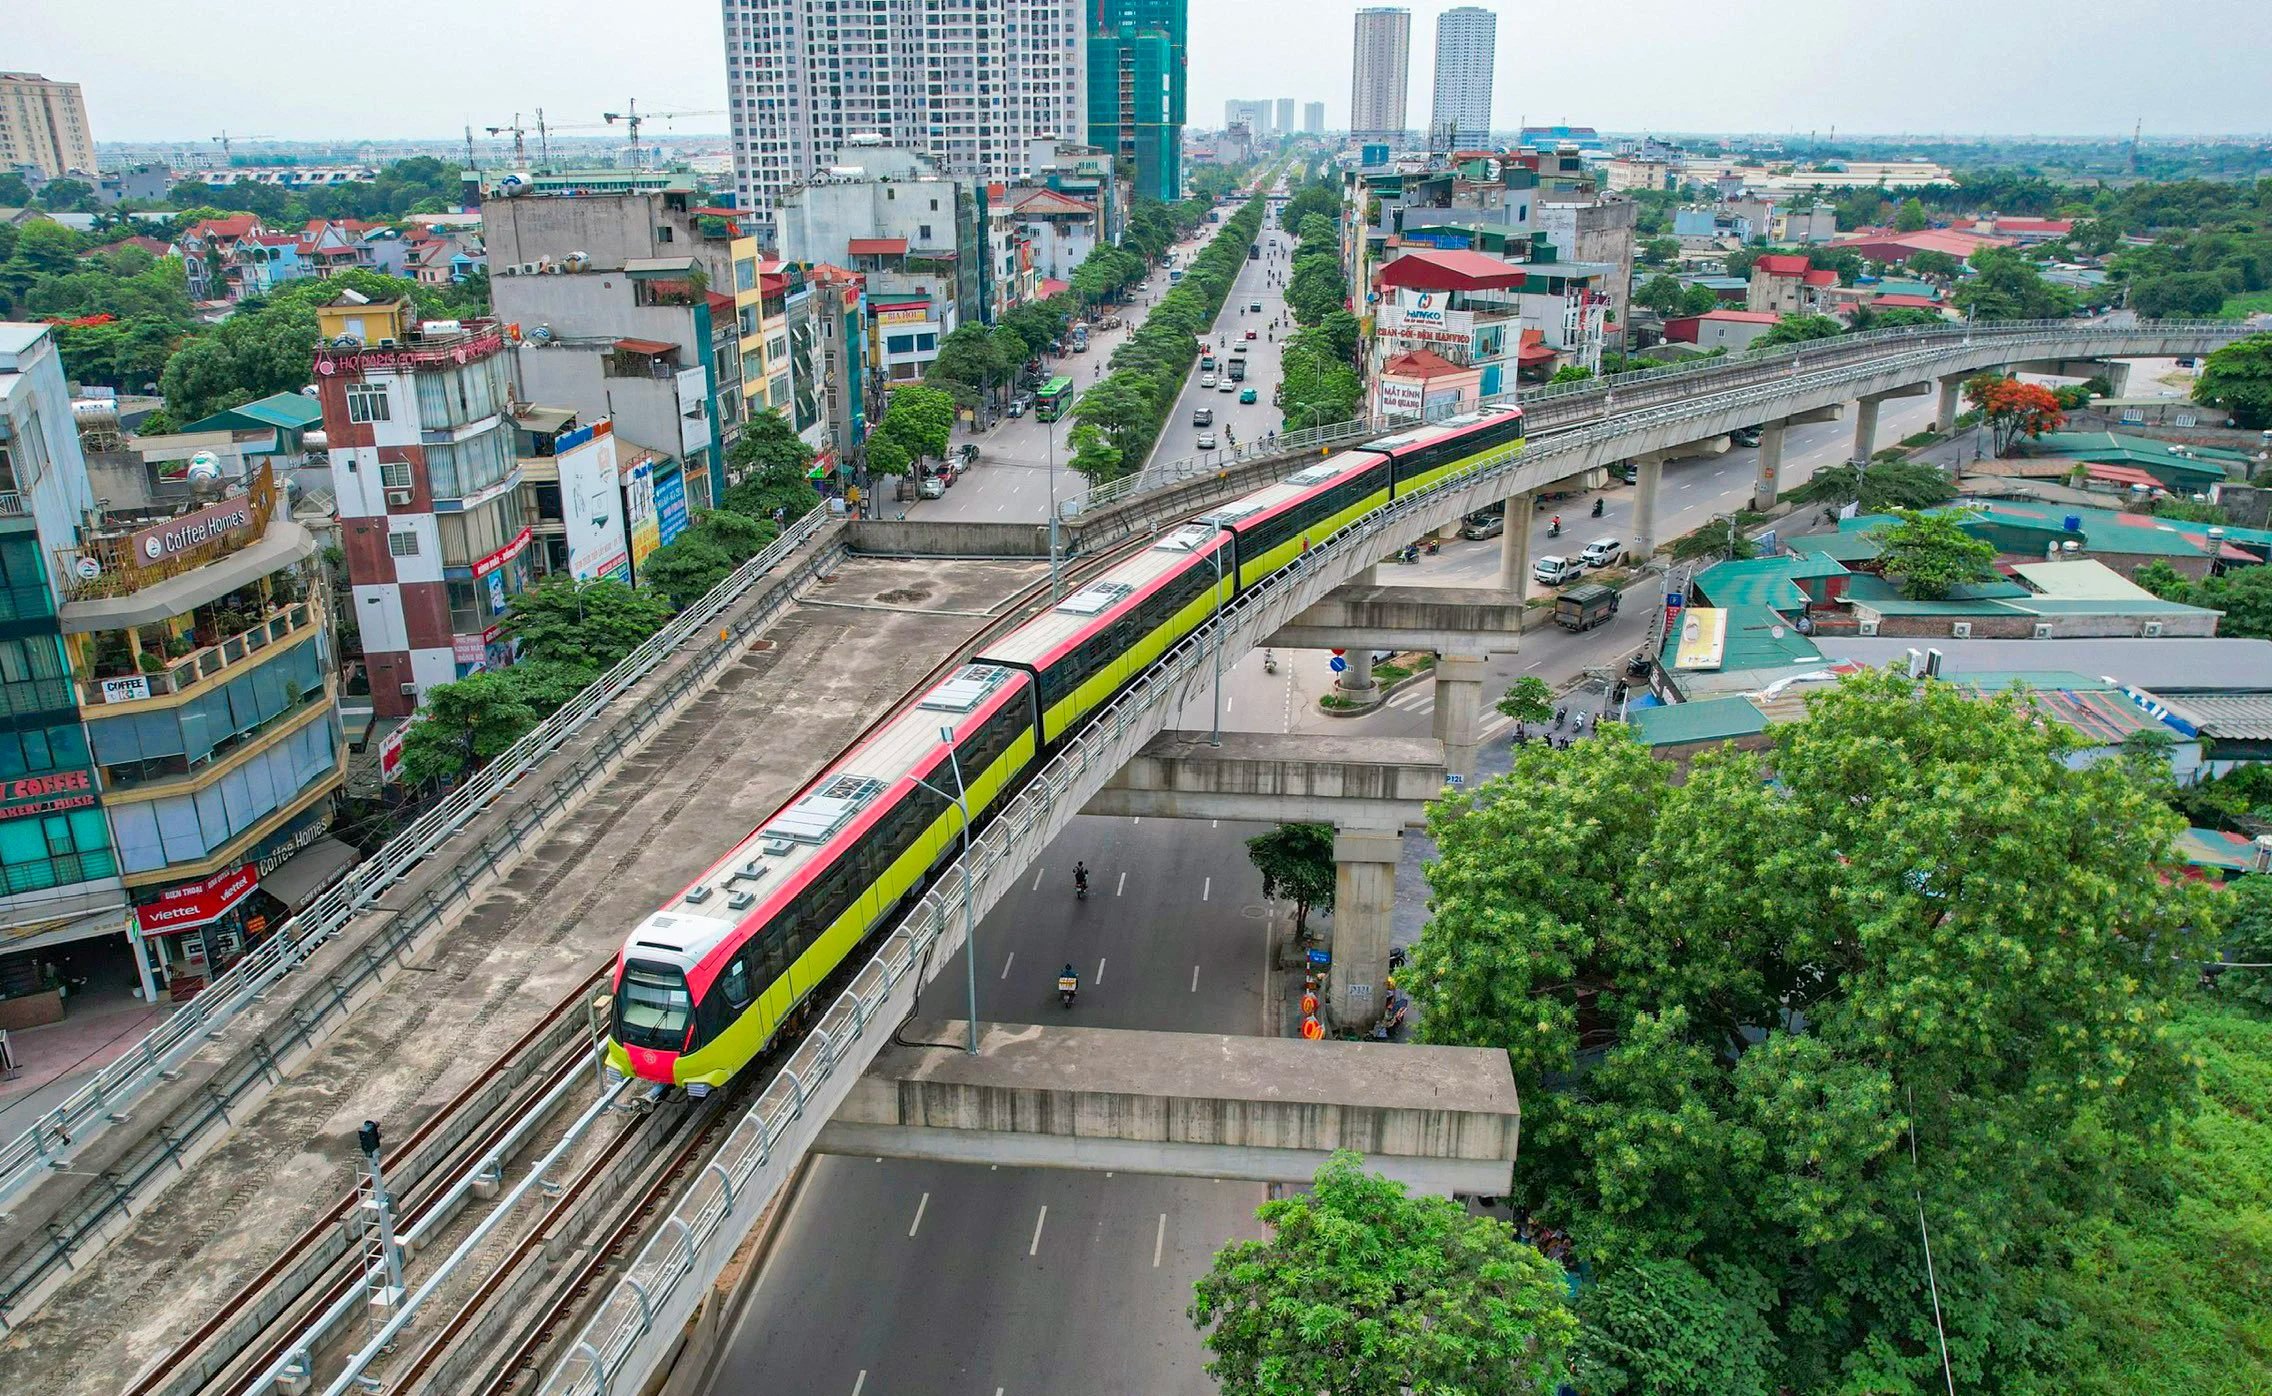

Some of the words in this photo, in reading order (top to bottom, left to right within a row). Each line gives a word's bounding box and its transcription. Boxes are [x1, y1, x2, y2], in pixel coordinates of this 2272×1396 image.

[165, 524, 206, 552] Coffee
[207, 509, 246, 537] Homes
[107, 679, 144, 691] COFFEE
[14, 770, 91, 798] COFFEE
[260, 843, 294, 877] Coffee
[295, 817, 328, 848] Homes
[220, 875, 248, 901] viettel
[300, 880, 328, 906] COFFEE
[149, 905, 201, 922] viettel
